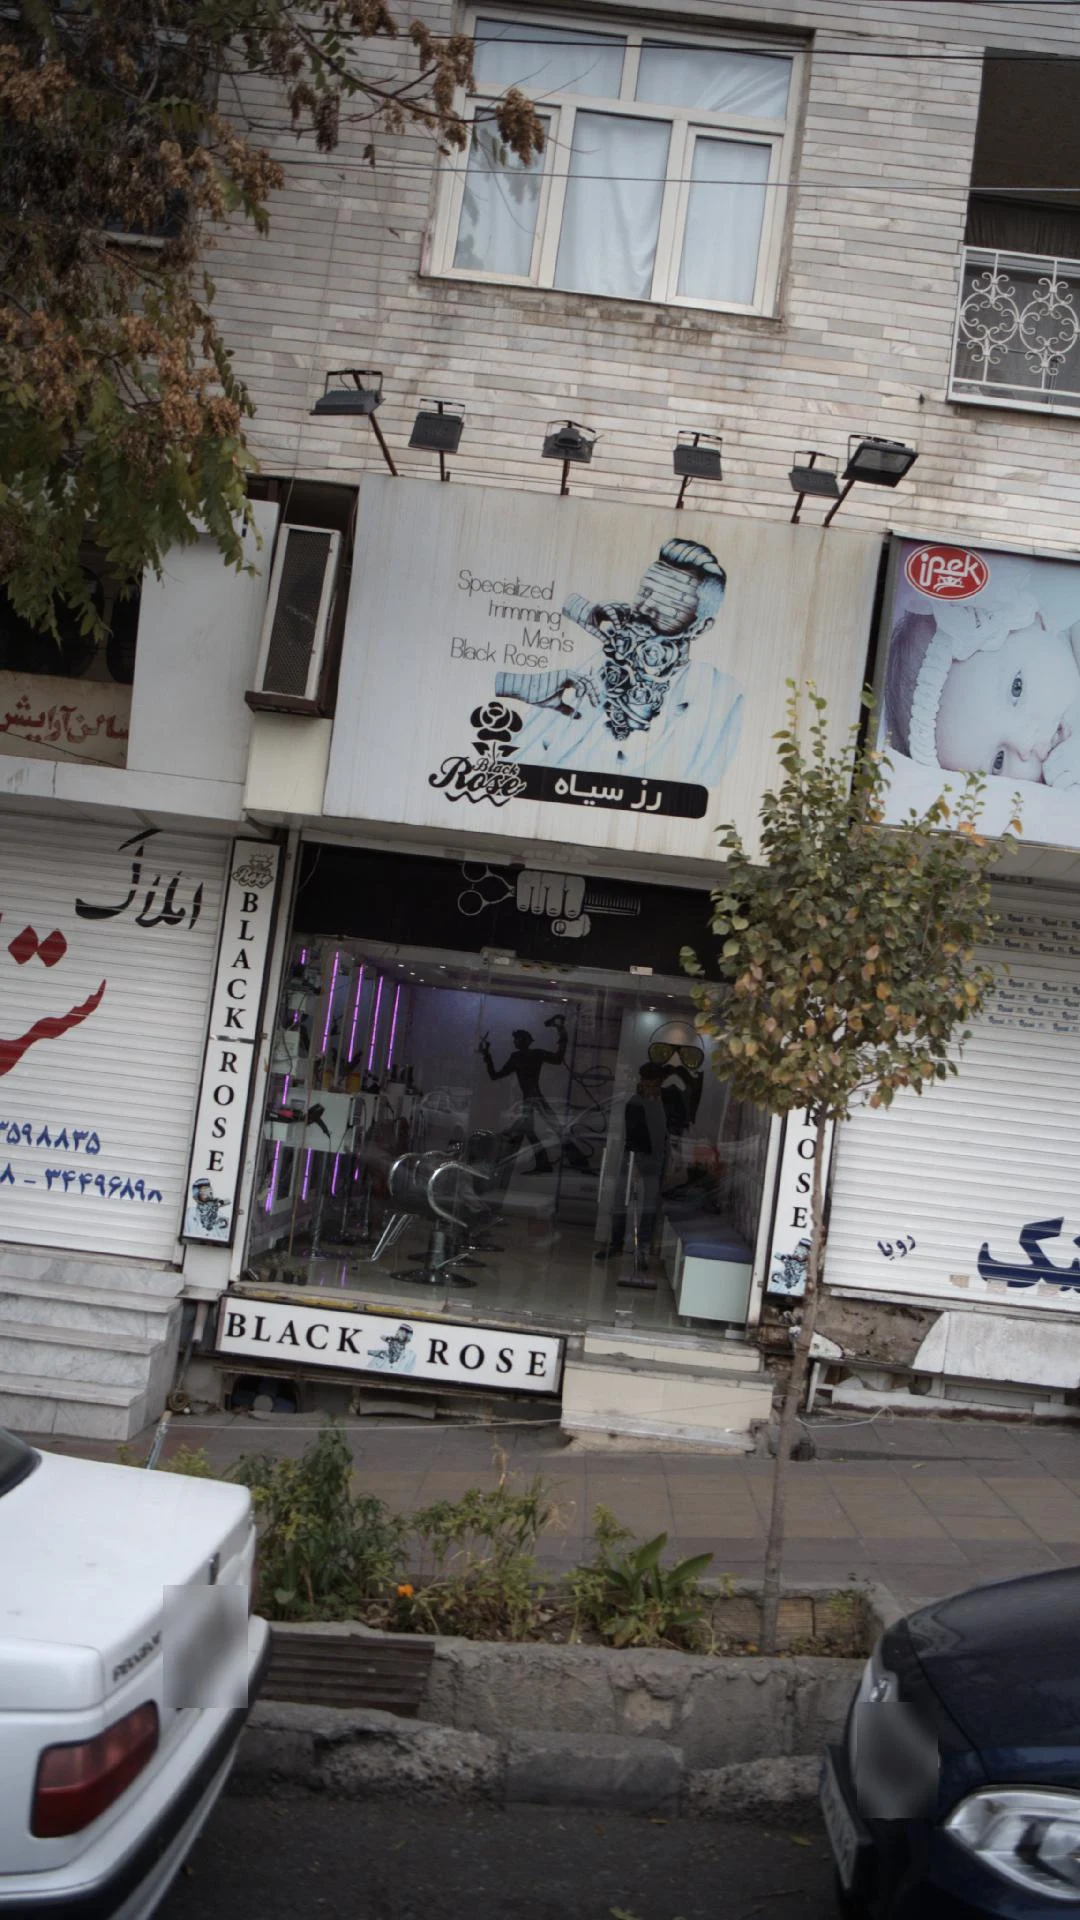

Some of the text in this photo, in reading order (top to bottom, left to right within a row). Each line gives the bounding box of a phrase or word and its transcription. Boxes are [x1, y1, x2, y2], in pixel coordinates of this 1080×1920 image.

[458, 569, 555, 599] Specialized
[918, 552, 983, 587] ipek
[450, 637, 549, 669] Black Rose
[522, 627, 575, 653] Men's
[428, 756, 527, 797] Rose
[471, 757, 520, 776] Black
[554, 774, 663, 811] رز سیاه
[224, 891, 258, 1030] BLACK
[206, 1051, 239, 1172] ROSE
[224, 1311, 548, 1378] BLACK ROSE
